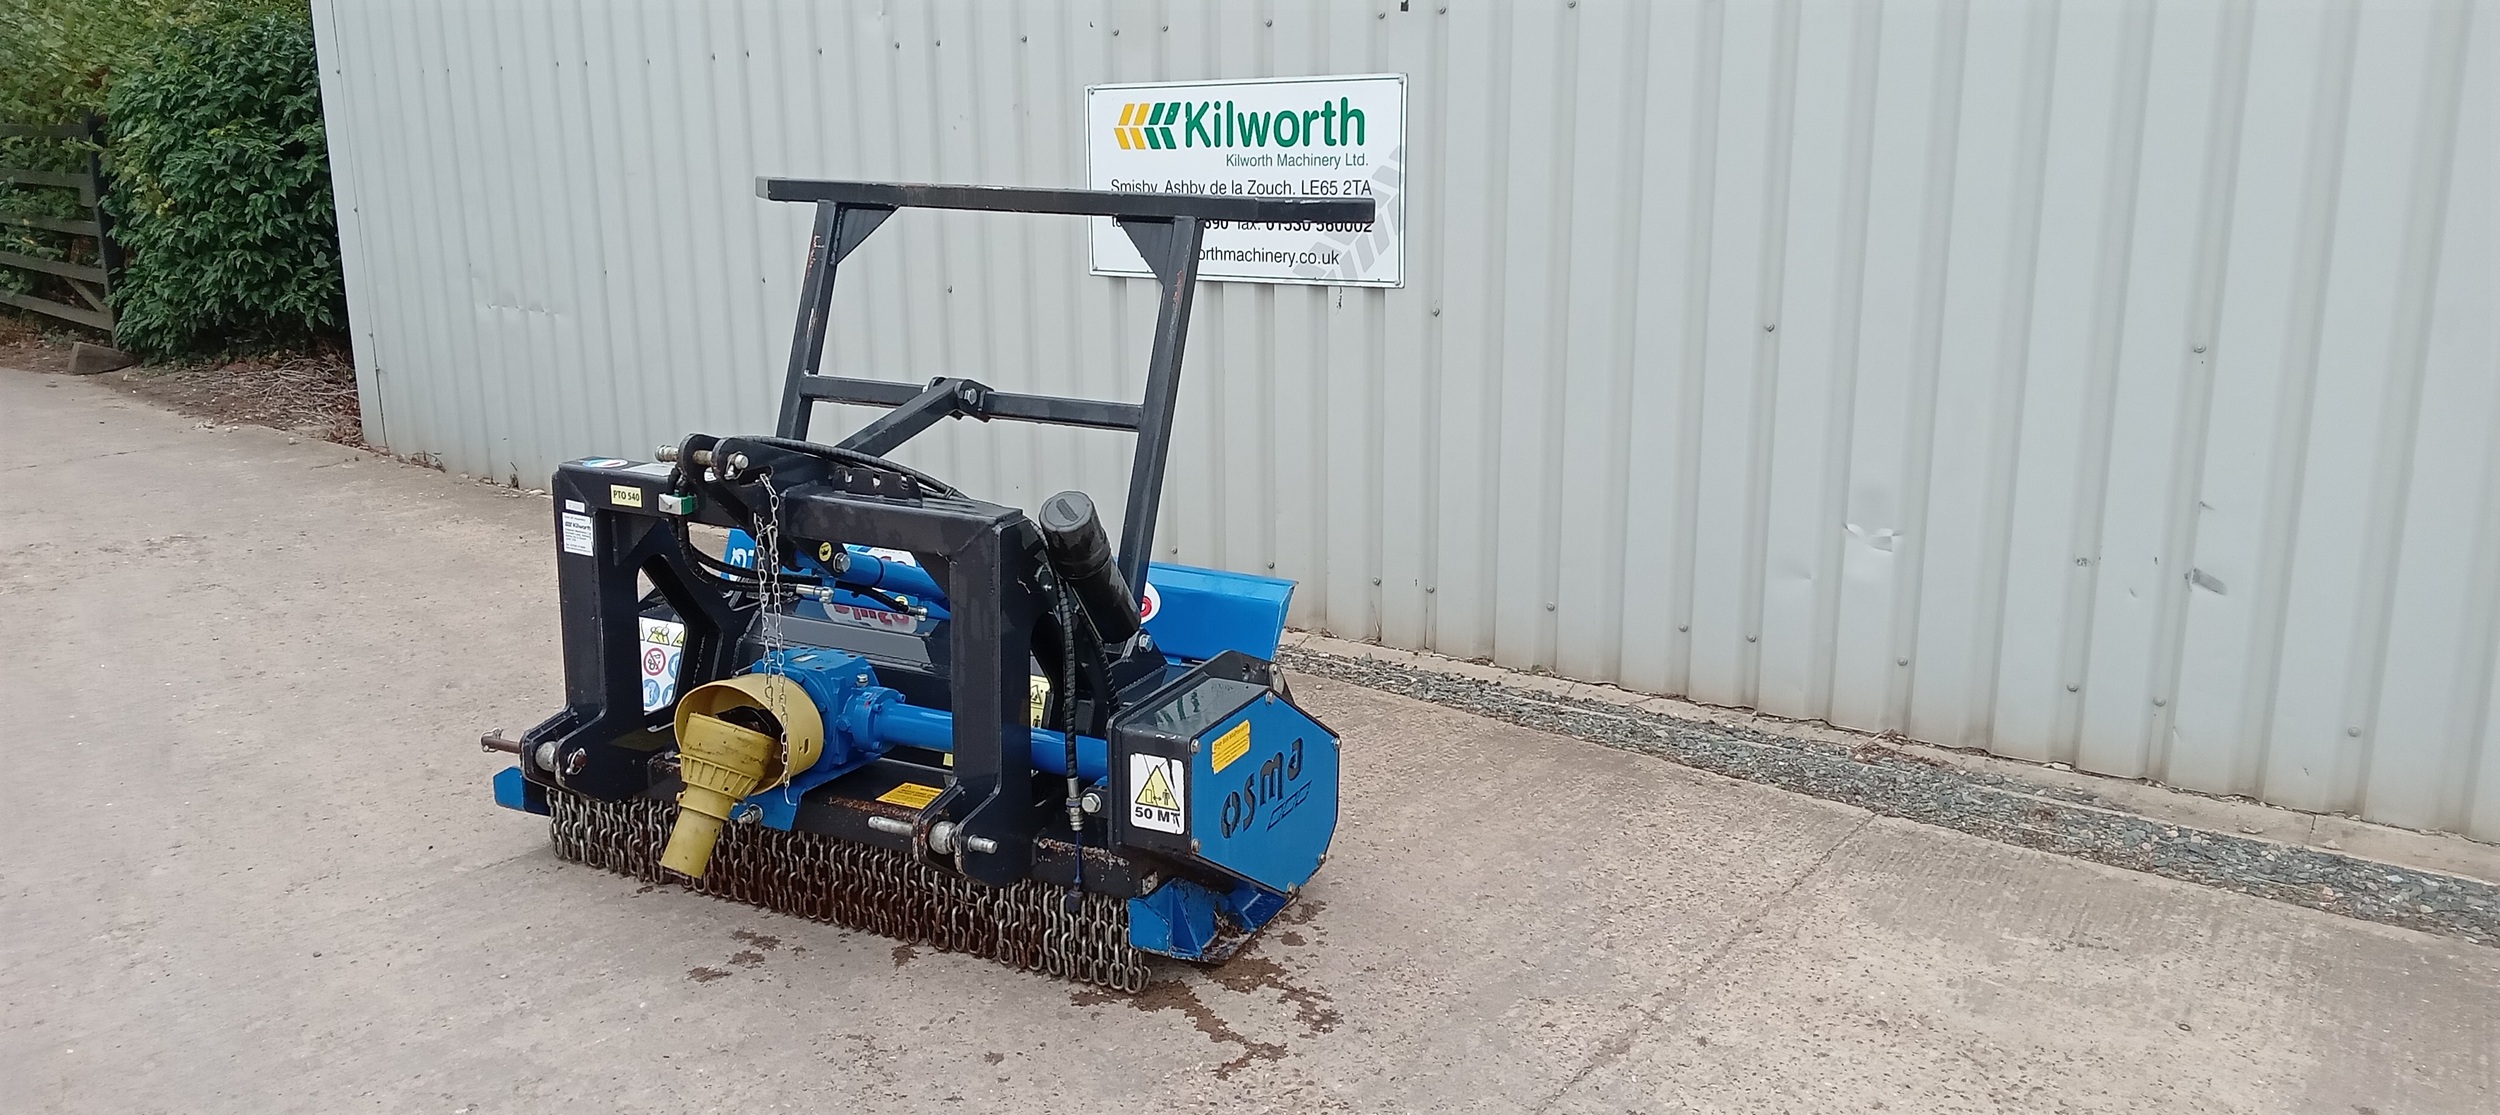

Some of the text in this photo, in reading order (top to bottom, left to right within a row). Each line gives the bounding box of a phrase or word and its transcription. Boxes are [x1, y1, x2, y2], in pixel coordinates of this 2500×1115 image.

[1185, 96, 1365, 148] Kilworth
[1226, 153, 1369, 170] Kilworth Machinery Ltd.
[1209, 180, 1227, 195] de
[1231, 180, 1243, 195] la
[1301, 180, 1338, 196] LE65
[1343, 180, 1372, 196] 2TA
[1198, 245, 1340, 268] orthmachinery.co.uk
[612, 489, 640, 502] PTO 540
[1135, 806, 1153, 820] 50
